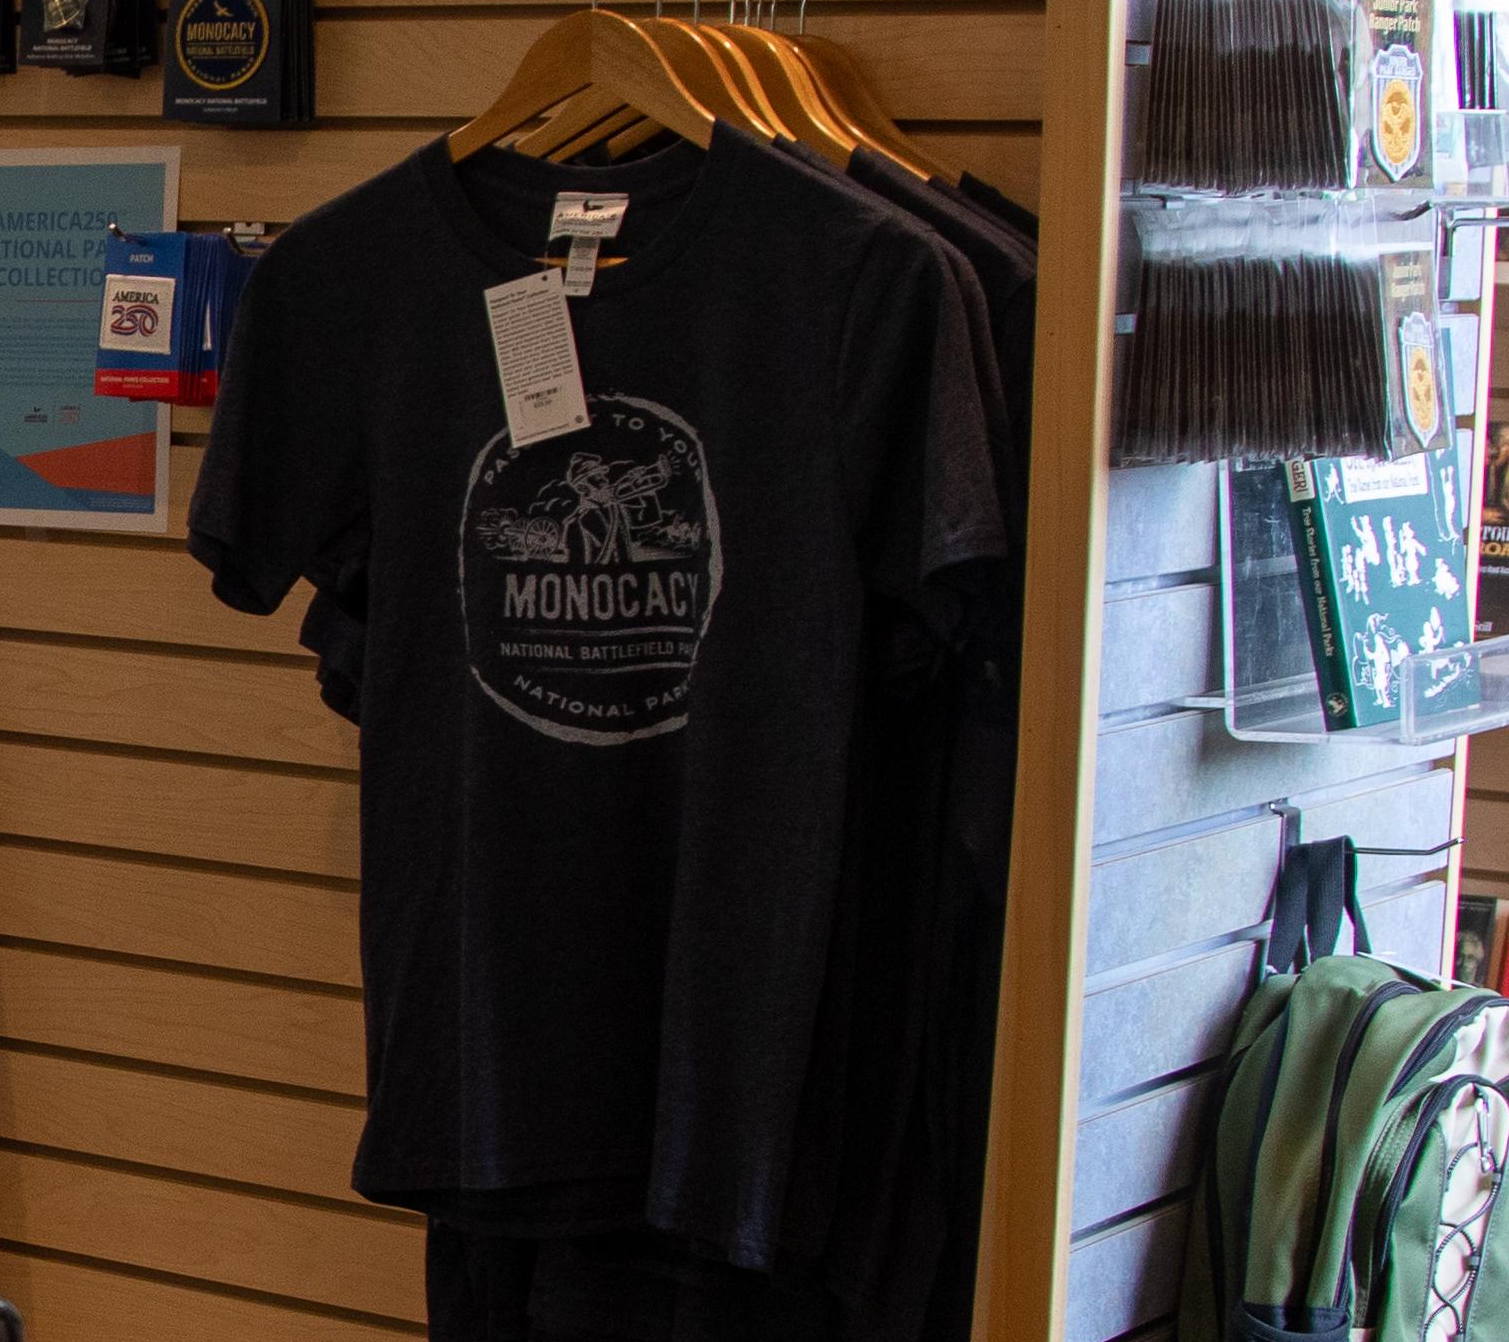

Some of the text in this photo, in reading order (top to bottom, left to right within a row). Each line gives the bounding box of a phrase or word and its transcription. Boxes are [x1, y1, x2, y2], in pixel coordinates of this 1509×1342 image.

[186, 21, 257, 42] MONOCACY
[1369, 12, 1422, 35] Ranger Patch
[83, 237, 106, 259] PA
[129, 253, 155, 264] PATCH
[111, 290, 160, 306] AMERICA
[110, 304, 160, 338] 250
[611, 413, 646, 433] TO
[503, 569, 699, 621] MONOCACY
[1316, 596, 1331, 632] National
[500, 640, 675, 661] NATIONAL BATTLEFIELD
[1322, 633, 1335, 658] Parks
[513, 673, 635, 718] NATIONAL
